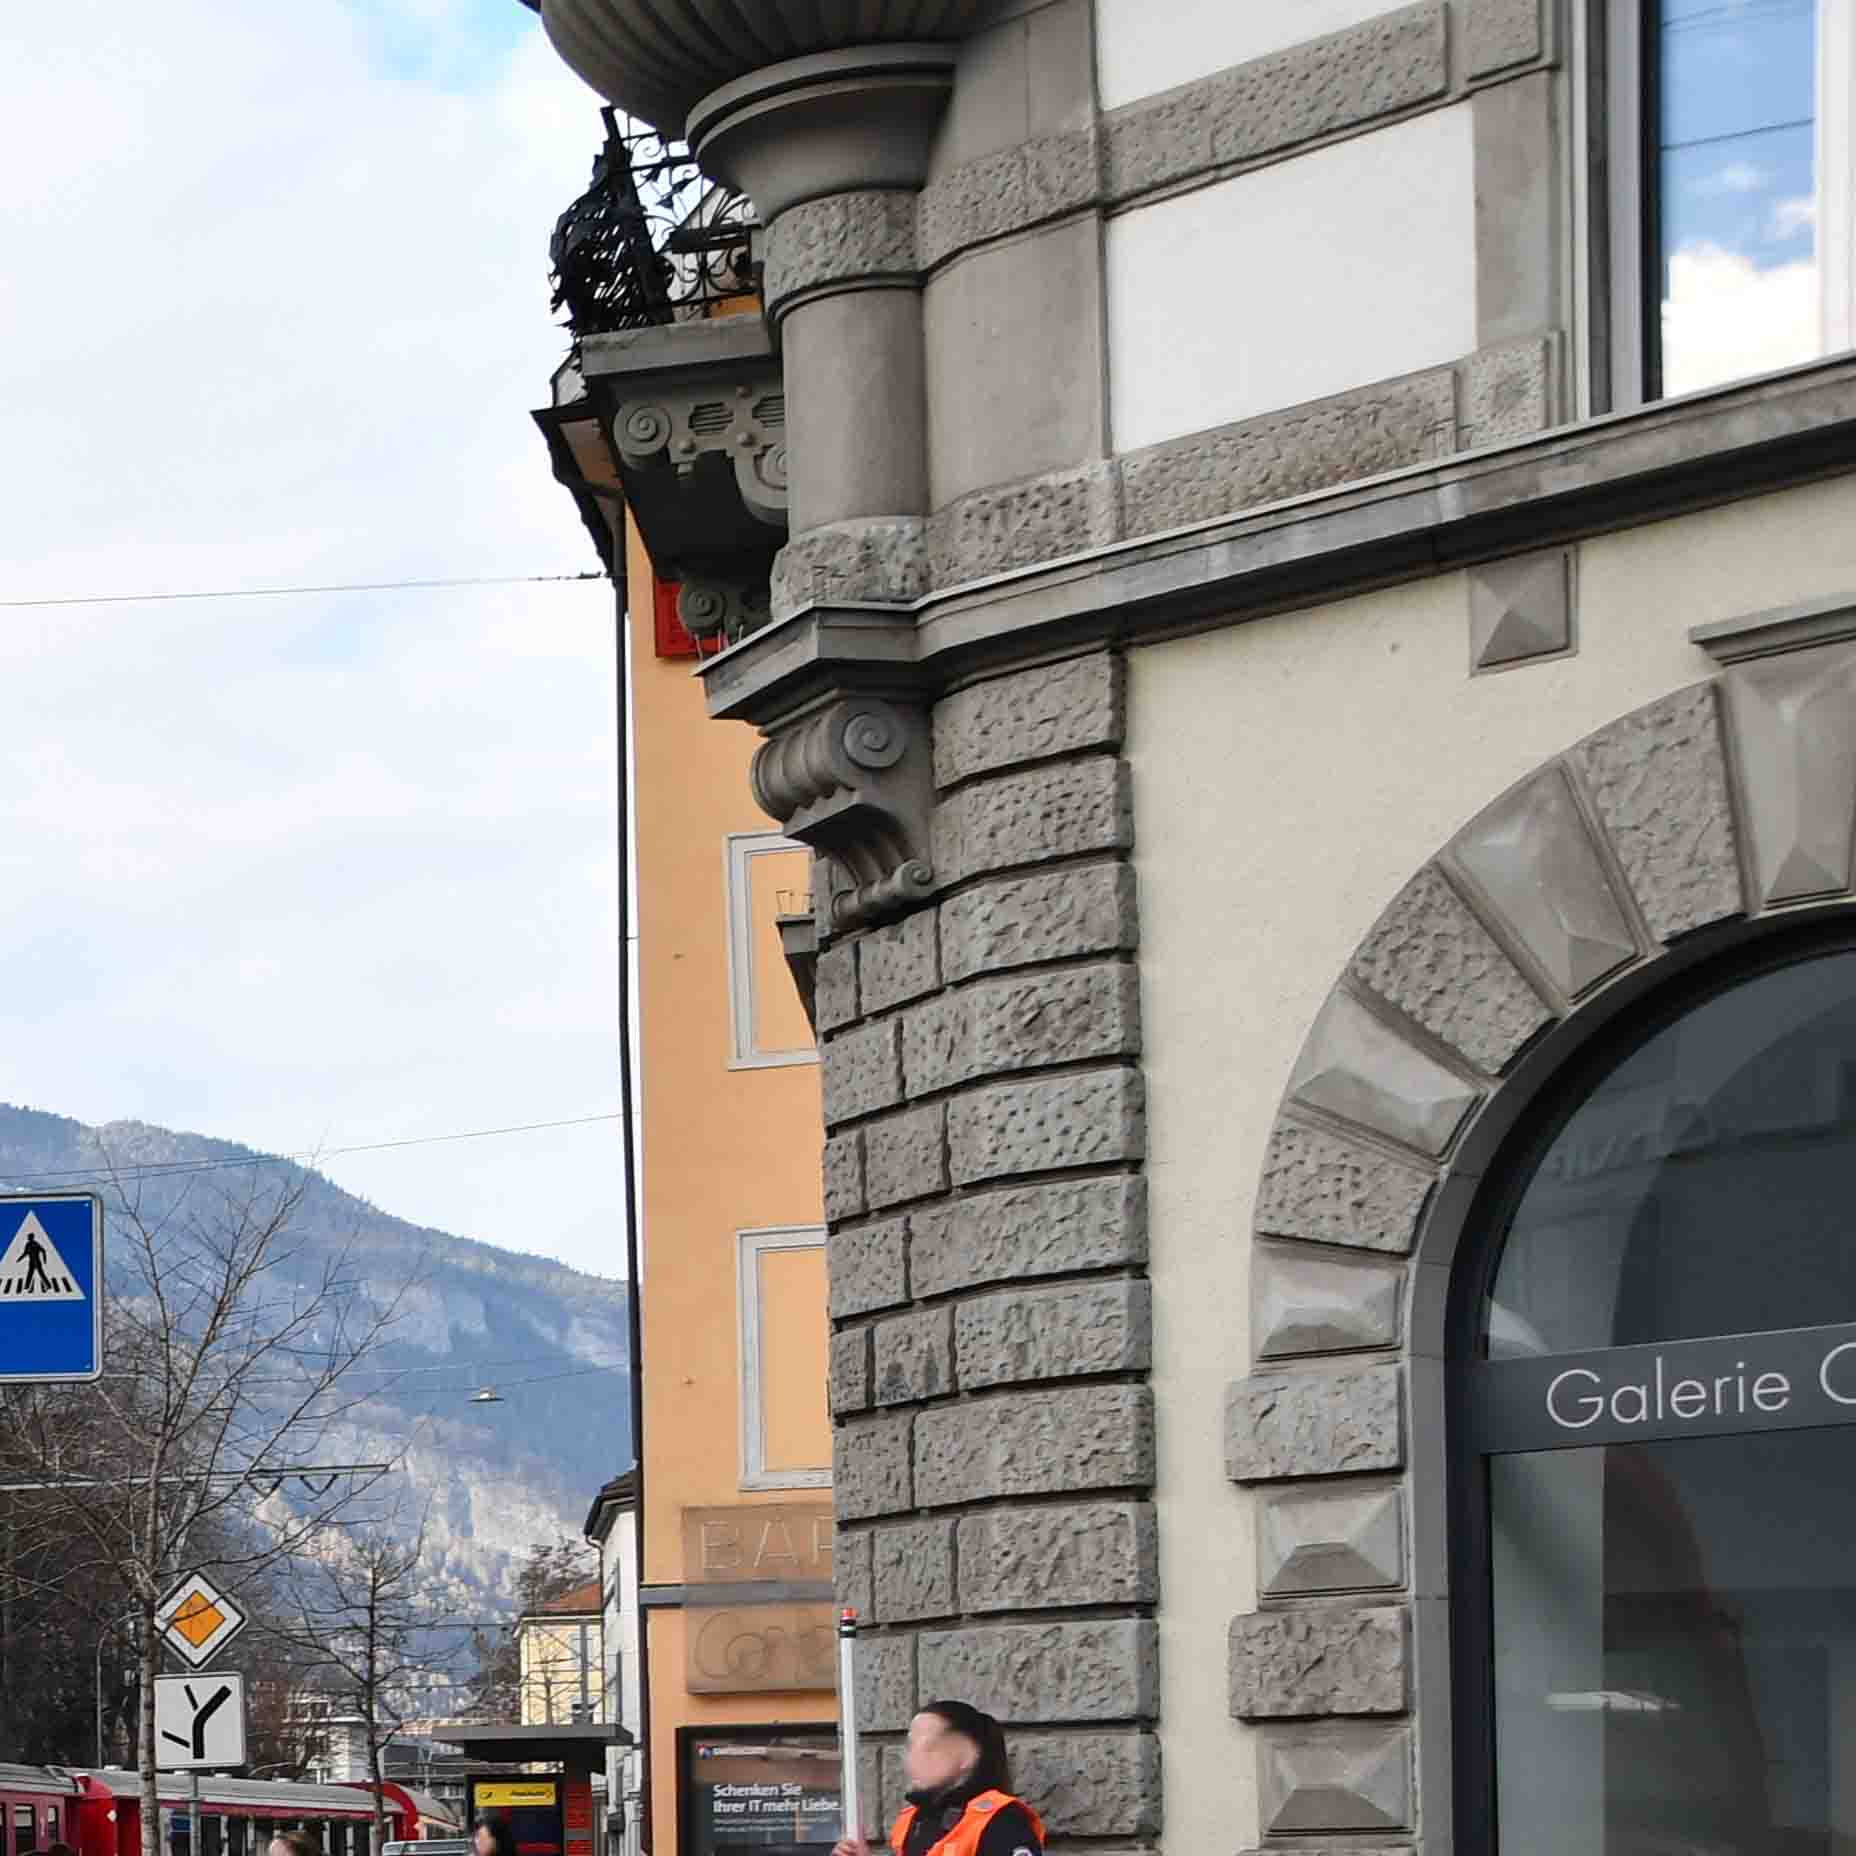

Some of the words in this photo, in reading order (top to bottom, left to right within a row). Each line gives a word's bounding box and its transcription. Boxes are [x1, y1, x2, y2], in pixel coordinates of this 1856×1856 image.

[1546, 1355, 1791, 1428] Galerie
[712, 1784, 779, 1798] Schenken
[781, 1782, 803, 1796] Sie
[712, 1799, 746, 1813] Ihrer
[748, 1800, 761, 1812] IT
[762, 1799, 800, 1812] mehr
